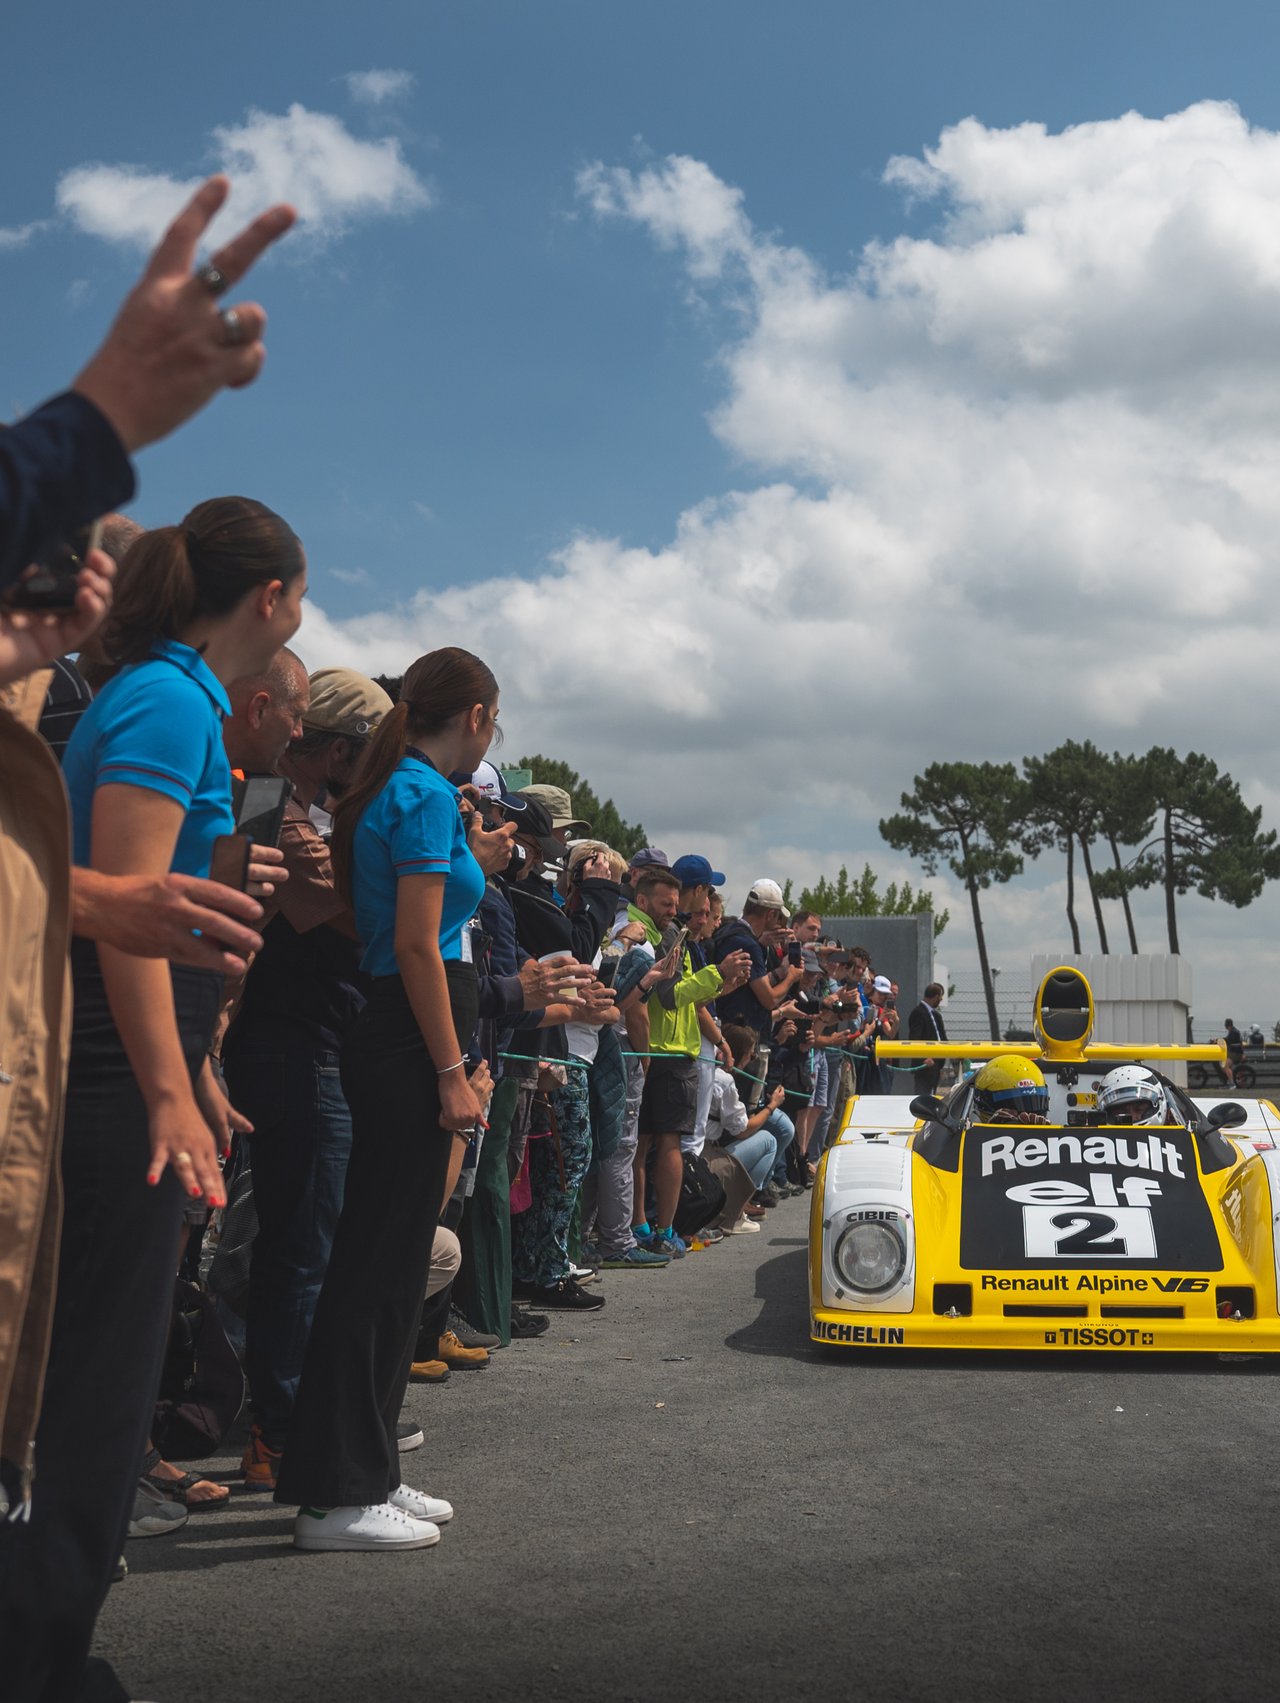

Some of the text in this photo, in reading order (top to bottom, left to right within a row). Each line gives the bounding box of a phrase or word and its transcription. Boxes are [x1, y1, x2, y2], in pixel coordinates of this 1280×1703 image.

[981, 1135, 1186, 1179] Renault
[1006, 1173, 1163, 1207] elf
[846, 1211, 899, 1223] CIBIE
[1051, 1212, 1127, 1256] 2
[981, 1275, 1210, 1294] Renault Alpine V6
[1059, 1328, 1140, 1346] TISSOT
